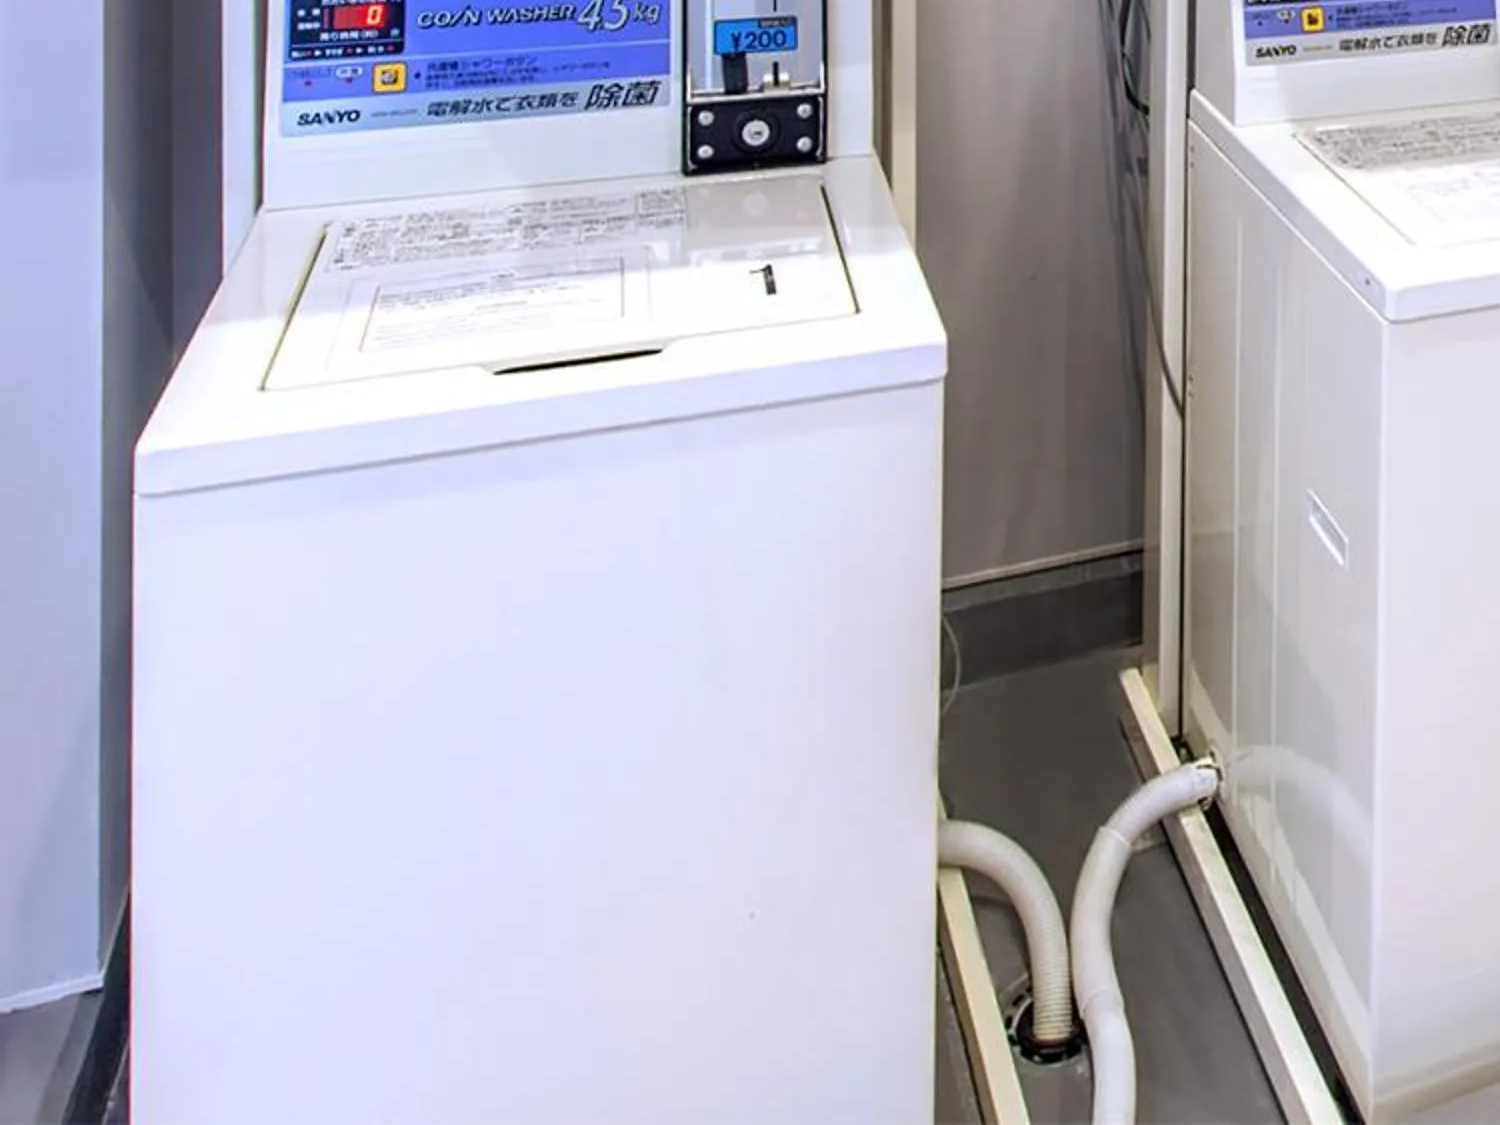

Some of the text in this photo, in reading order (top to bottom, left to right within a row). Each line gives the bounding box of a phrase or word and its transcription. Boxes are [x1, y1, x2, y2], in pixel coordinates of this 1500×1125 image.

[367, 4, 384, 25] 0
[416, 6, 483, 29] COIN
[486, 3, 577, 25] WASHER
[730, 29, 788, 51] ¥200
[1255, 44, 1297, 59] SANYO
[584, 80, 661, 111] 除菌
[296, 109, 361, 126] SANYO
[749, 263, 777, 295] 1
